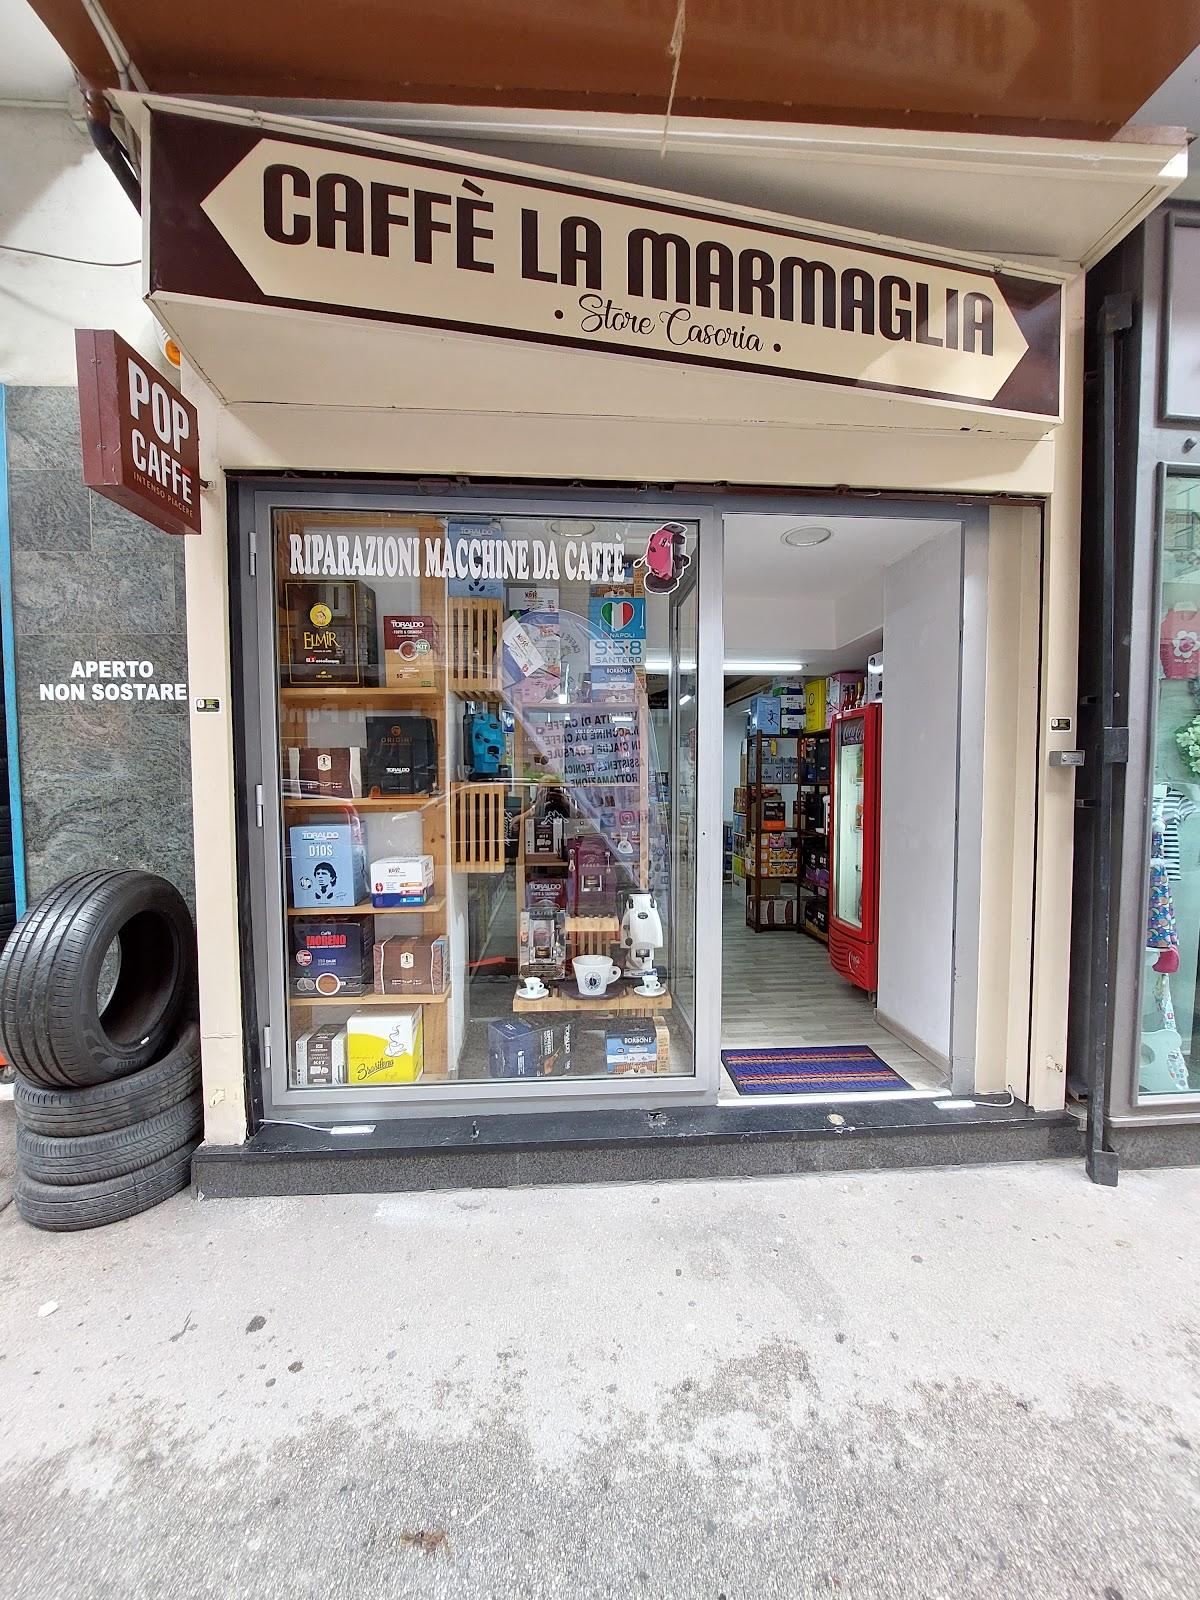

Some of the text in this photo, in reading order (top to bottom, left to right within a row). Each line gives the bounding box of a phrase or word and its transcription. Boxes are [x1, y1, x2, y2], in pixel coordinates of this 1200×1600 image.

[263, 163, 994, 356] CAFFÈ LA MARMAGLIA
[578, 293, 764, 352] Store Casoria
[127, 357, 190, 454] POP
[133, 471, 193, 519] INTENSO PIACERE
[289, 531, 626, 583] RIPARAZIONI MACCHINE DA CAFFÈ
[71, 660, 154, 678] APERTO
[594, 656, 642, 664] SANTERO
[39, 683, 188, 701] NON SOSTARE
[306, 935, 347, 946] MORENO
[624, 1035, 652, 1044] BORBONE
